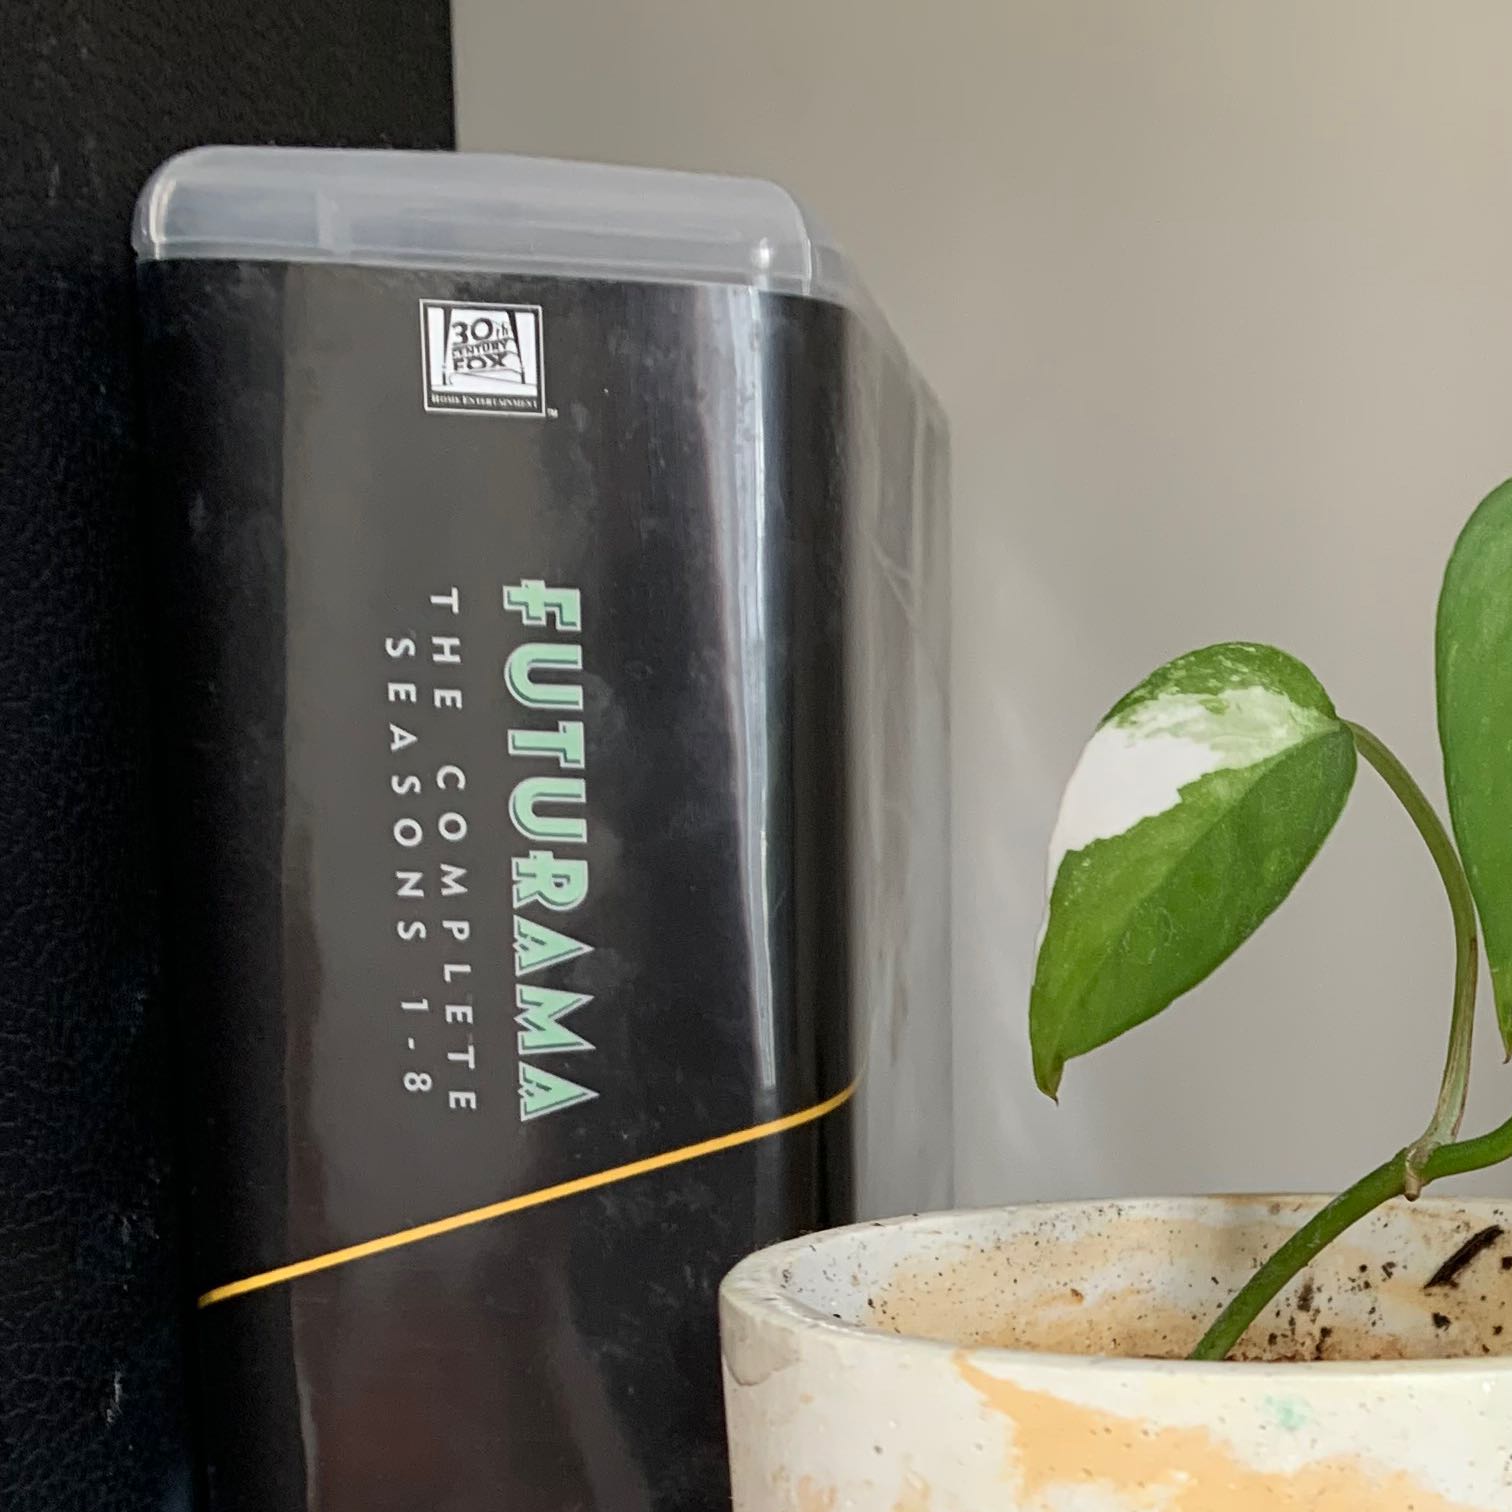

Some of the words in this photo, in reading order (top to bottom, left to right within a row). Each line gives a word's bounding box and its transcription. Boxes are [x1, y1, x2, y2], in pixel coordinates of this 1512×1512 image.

[451, 317, 509, 344] 30th
[452, 351, 507, 371] FOX
[430, 393, 459, 405] HOME
[461, 394, 538, 409] ENTERTAINMENT
[429, 586, 463, 710] THE
[384, 637, 427, 941] SEASONS
[502, 578, 601, 1122] FUTURAMA
[436, 764, 478, 1110] COMPLETE
